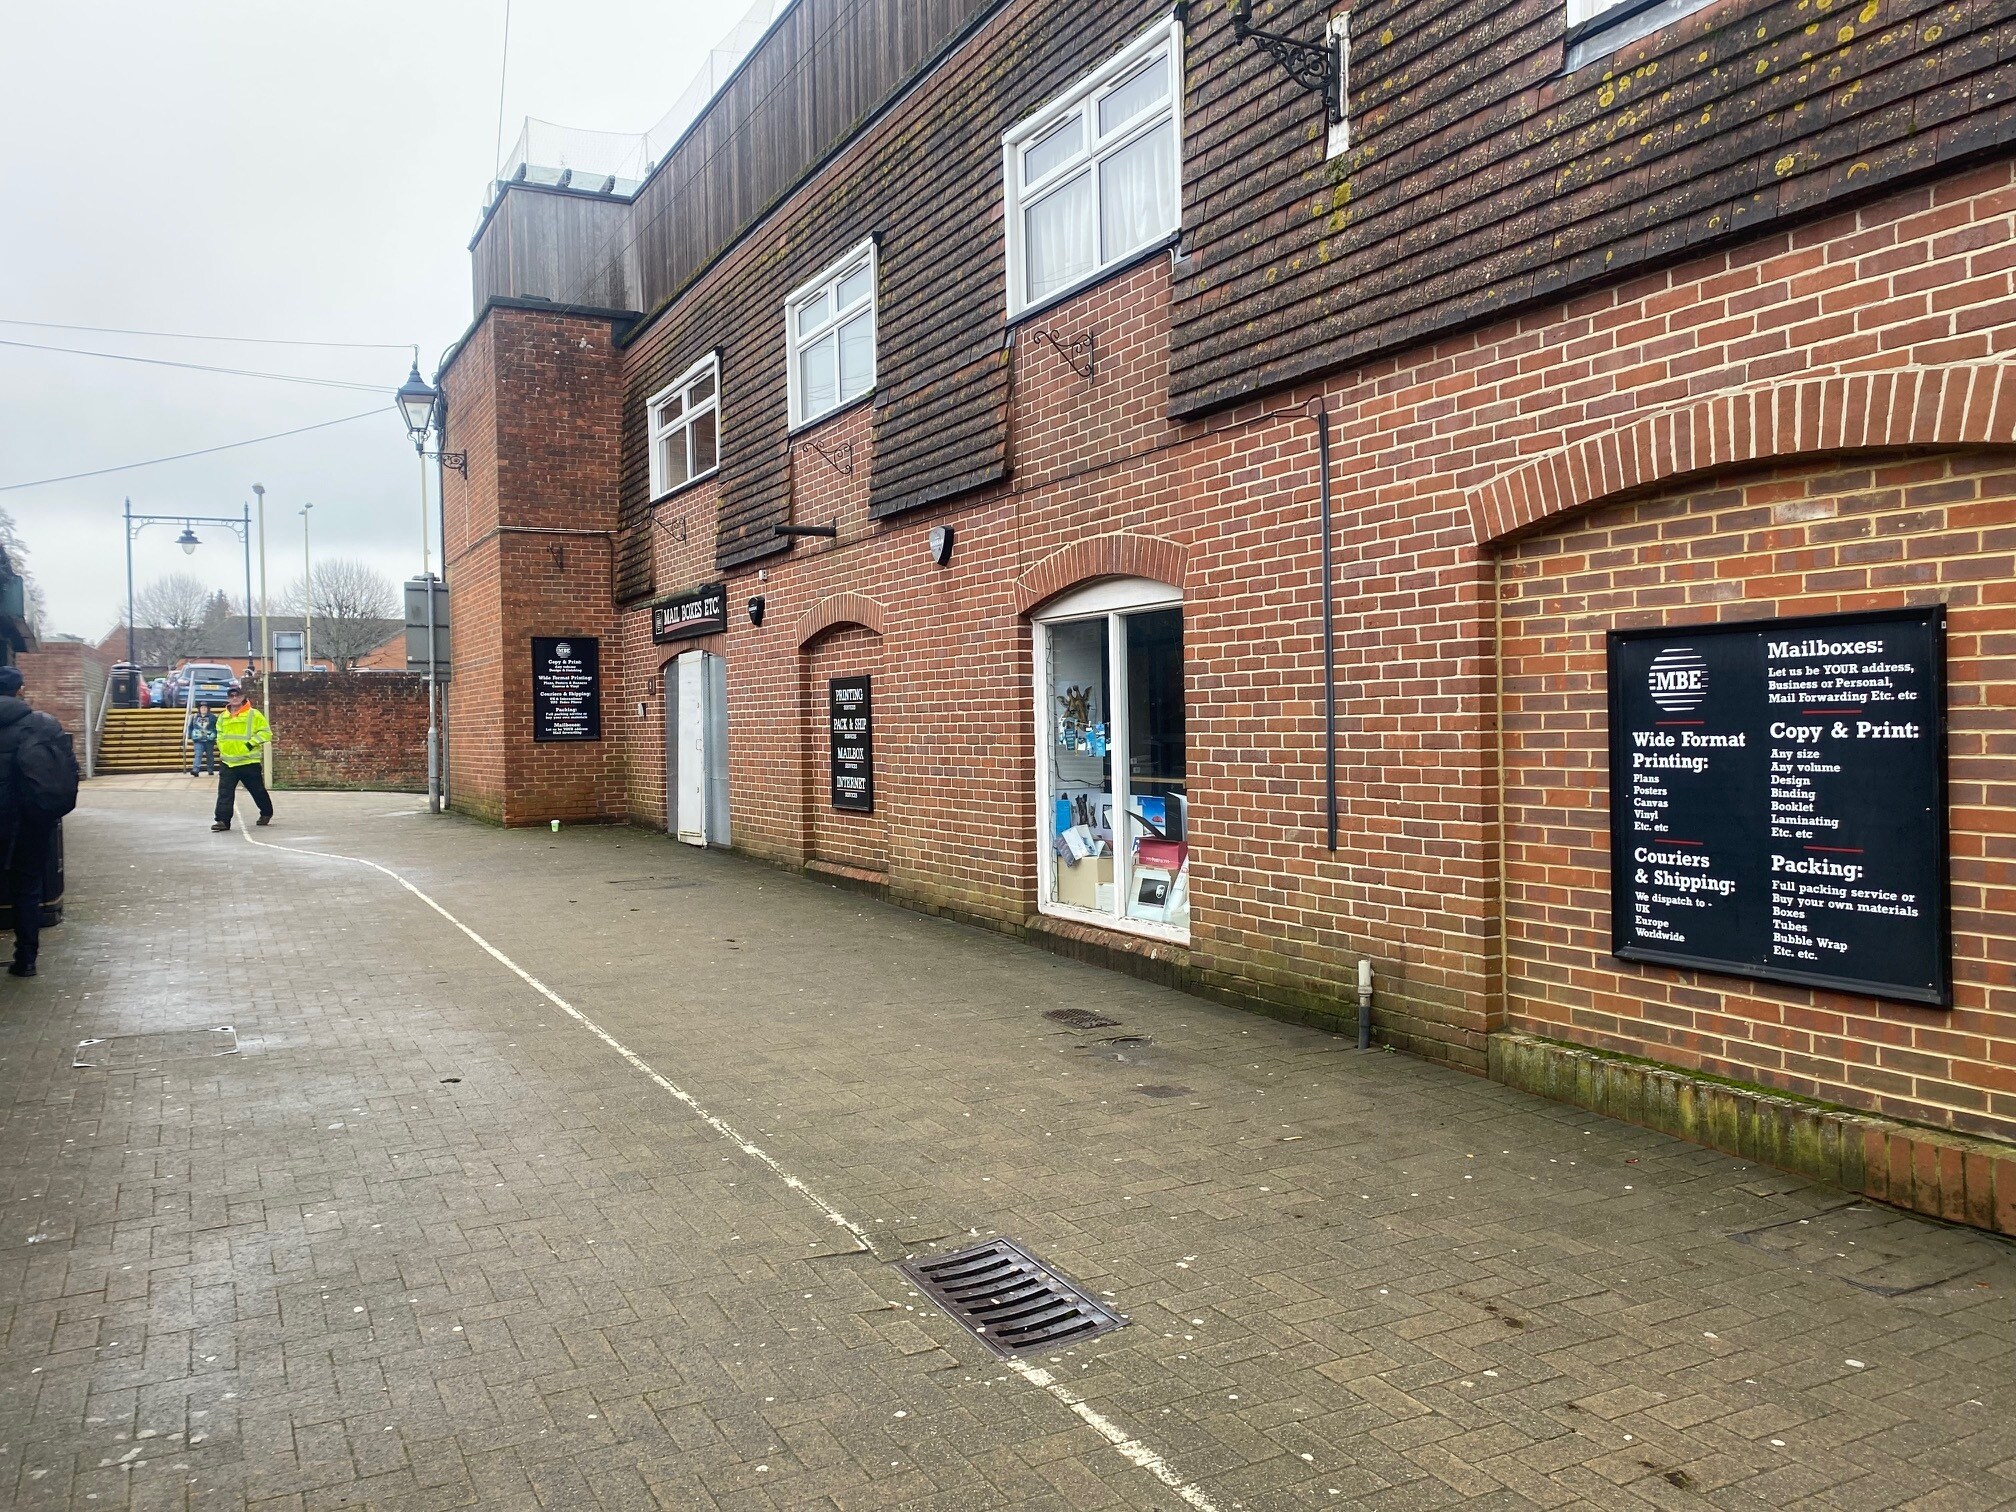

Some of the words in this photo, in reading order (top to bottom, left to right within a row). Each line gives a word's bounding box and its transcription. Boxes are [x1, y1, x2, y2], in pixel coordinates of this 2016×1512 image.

[664, 607, 680, 625] MAIL
[681, 601, 702, 621] BOXES
[1768, 639, 1883, 658] Mailboxes:
[1768, 668, 1786, 677] Let
[1805, 666, 1820, 675] be
[1823, 664, 1859, 674] YOUR
[1862, 662, 1914, 673] address,
[1656, 671, 1702, 690] MBE
[1768, 680, 1818, 690] Business
[1835, 676, 1893, 688] Personal,
[835, 688, 863, 701] PRINTING
[1769, 693, 1796, 703] Mail
[1799, 691, 1868, 703] Forwarding
[1871, 691, 1894, 700] Etc.
[1898, 691, 1917, 700] etc
[834, 718, 847, 730] PACK
[849, 719, 853, 730] &
[855, 718, 866, 730] SHIP
[1770, 722, 1823, 743] Copy
[1831, 722, 1848, 738] &
[1856, 721, 1918, 738] Print:
[1632, 732, 1675, 747] Wide
[1681, 731, 1745, 747] Format
[837, 747, 864, 760] MAILBOX
[1770, 749, 1793, 761] Any
[1797, 749, 1820, 758] size
[1633, 753, 1708, 773] Printing:
[1771, 762, 1793, 774] Any
[1797, 762, 1840, 772] volume
[837, 776, 866, 789] INTERNET
[1633, 774, 1659, 783] Plans
[1771, 775, 1811, 787] Design
[1634, 786, 1667, 795] Posters
[1771, 788, 1816, 801] Binding
[1634, 798, 1668, 807] Canvas
[1771, 801, 1813, 812] Booklet
[1634, 809, 1658, 821] Vinyl
[1771, 814, 1839, 829] Laminating
[1634, 821, 1652, 831] Etc.
[1654, 824, 1668, 832] etc
[1771, 827, 1792, 837] Etc.
[1795, 830, 1813, 838] etc
[1635, 847, 1709, 867] Couriers
[1771, 855, 1862, 882] Packing:
[1635, 868, 1648, 883] &
[1654, 870, 1735, 895] Shipping:
[1772, 880, 1795, 891] Full
[1799, 884, 1847, 898] packing
[1851, 889, 1897, 900] service
[1902, 894, 1915, 902] or
[1635, 891, 1649, 901] We
[1652, 893, 1693, 906] dispatch
[1695, 899, 1705, 907] to
[1772, 893, 1794, 906] Buy
[1797, 898, 1824, 907] your
[1828, 901, 1853, 910] own
[1857, 904, 1918, 917] materials
[1635, 903, 1650, 913] UK
[1773, 906, 1805, 918] Boxes
[1635, 915, 1669, 929] Europe
[1773, 919, 1807, 932] Tubes
[1635, 927, 1685, 942] Worldwide
[1773, 932, 1812, 946] Bubble
[1816, 937, 1847, 953] Wrap
[1773, 945, 1794, 957] Etc.
[1798, 950, 1817, 960] etc.
